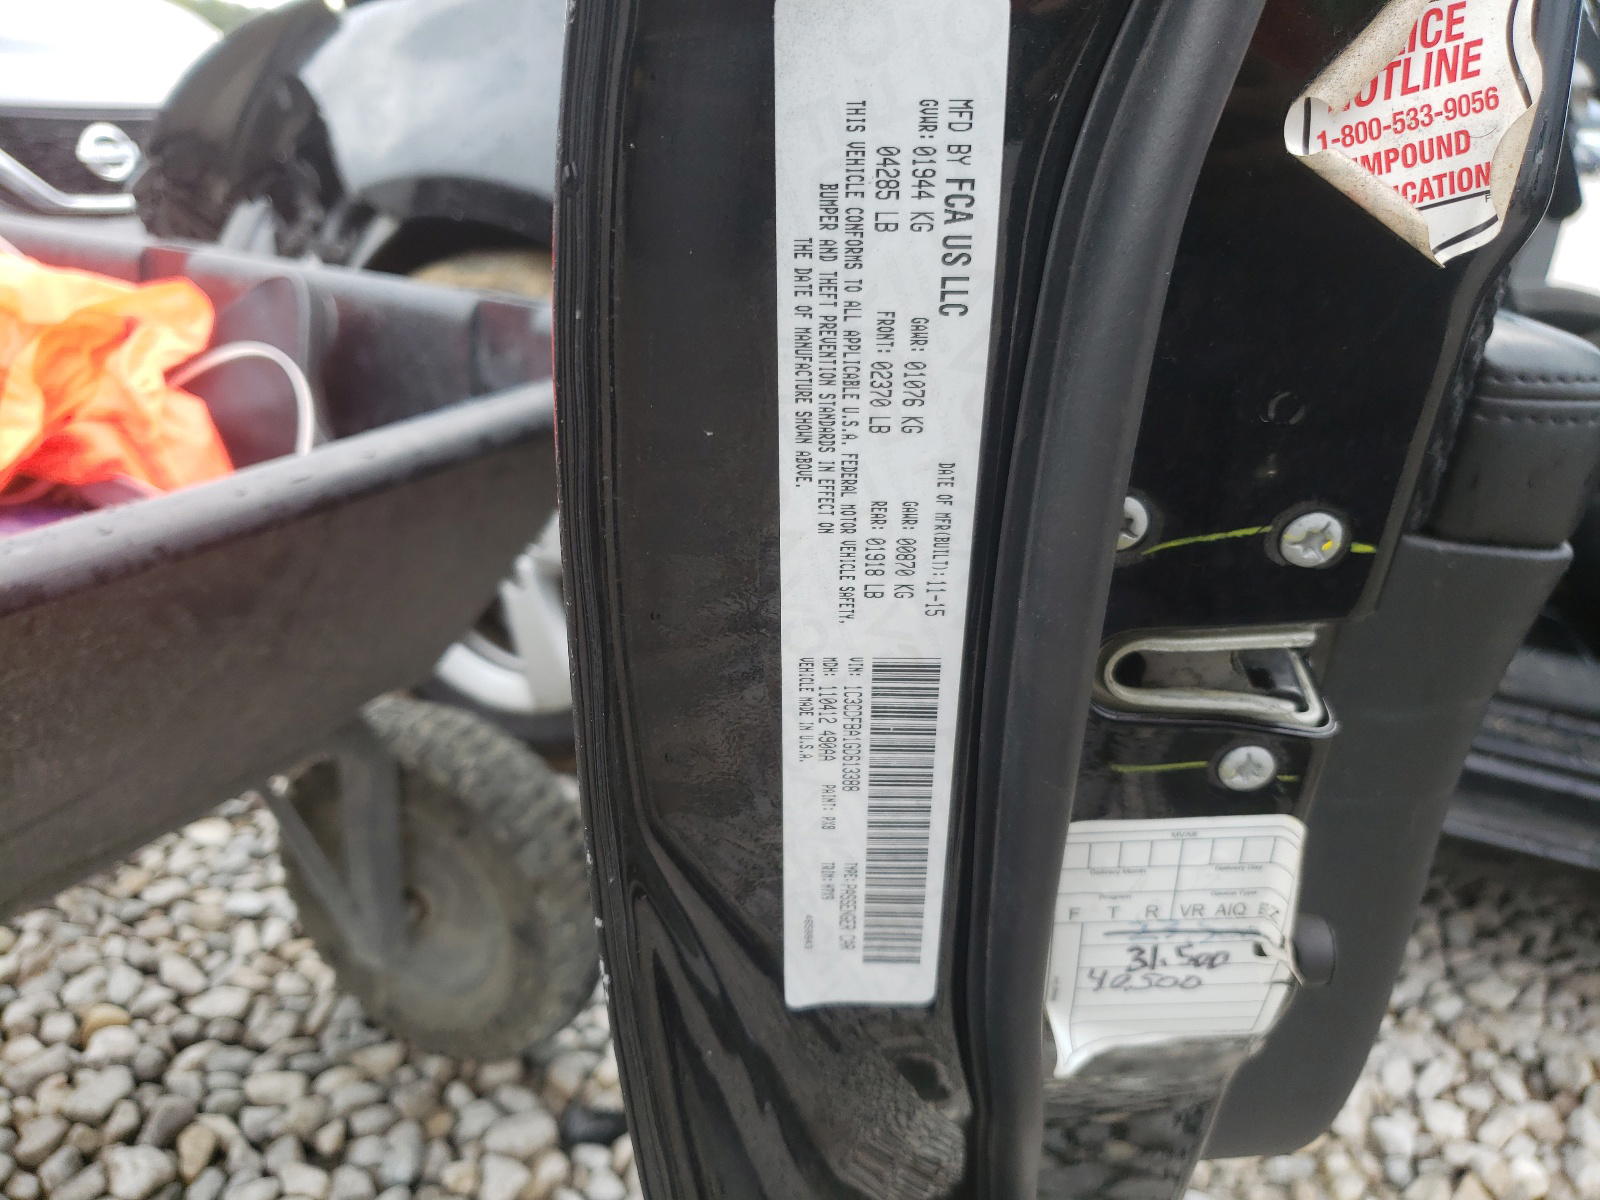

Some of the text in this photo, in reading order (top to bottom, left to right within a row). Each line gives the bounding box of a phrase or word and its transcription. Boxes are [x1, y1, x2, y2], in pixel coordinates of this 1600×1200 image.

[1398, 1, 1466, 55] ICE
[1328, 38, 1483, 113] OTLINE
[1316, 86, 1499, 150] 1-800-533-9056
[909, 99, 939, 233] GVWR: 01944 KG
[1352, 129, 1471, 176] MPOUND
[874, 146, 901, 233] 04285 LB
[938, 99, 976, 317] MFD BY FCA US LLC
[793, 237, 813, 488] THE DATE OF MANUFACTURE SHOWN ABOVE.
[817, 183, 839, 534] BUMPER AND THEFT PREVENTION STANDARDS IN EFFECT ON
[838, 100, 867, 624] THIS VEHICLE CONFORMS TO ALL APPLICABLE U.S.A. FEDERAL MOTOR VEHICLE SAFETY,
[868, 311, 896, 434] FRONT: 02370 LB
[900, 317, 930, 434] GAWR: 01076 KG
[935, 494, 953, 506] OF
[936, 462, 956, 488] DATE
[863, 501, 888, 600] REAR: 01918 LB
[893, 501, 919, 600] GAWR: 00870 KG
[924, 581, 947, 617] 11-15
[798, 657, 815, 692] VEHICLE
[822, 657, 839, 677] MDH:
[847, 657, 864, 676] VIN:
[798, 697, 815, 717] MADE
[799, 722, 815, 731] IN
[818, 686, 838, 724] 110412
[1180, 903, 1205, 918] VR
